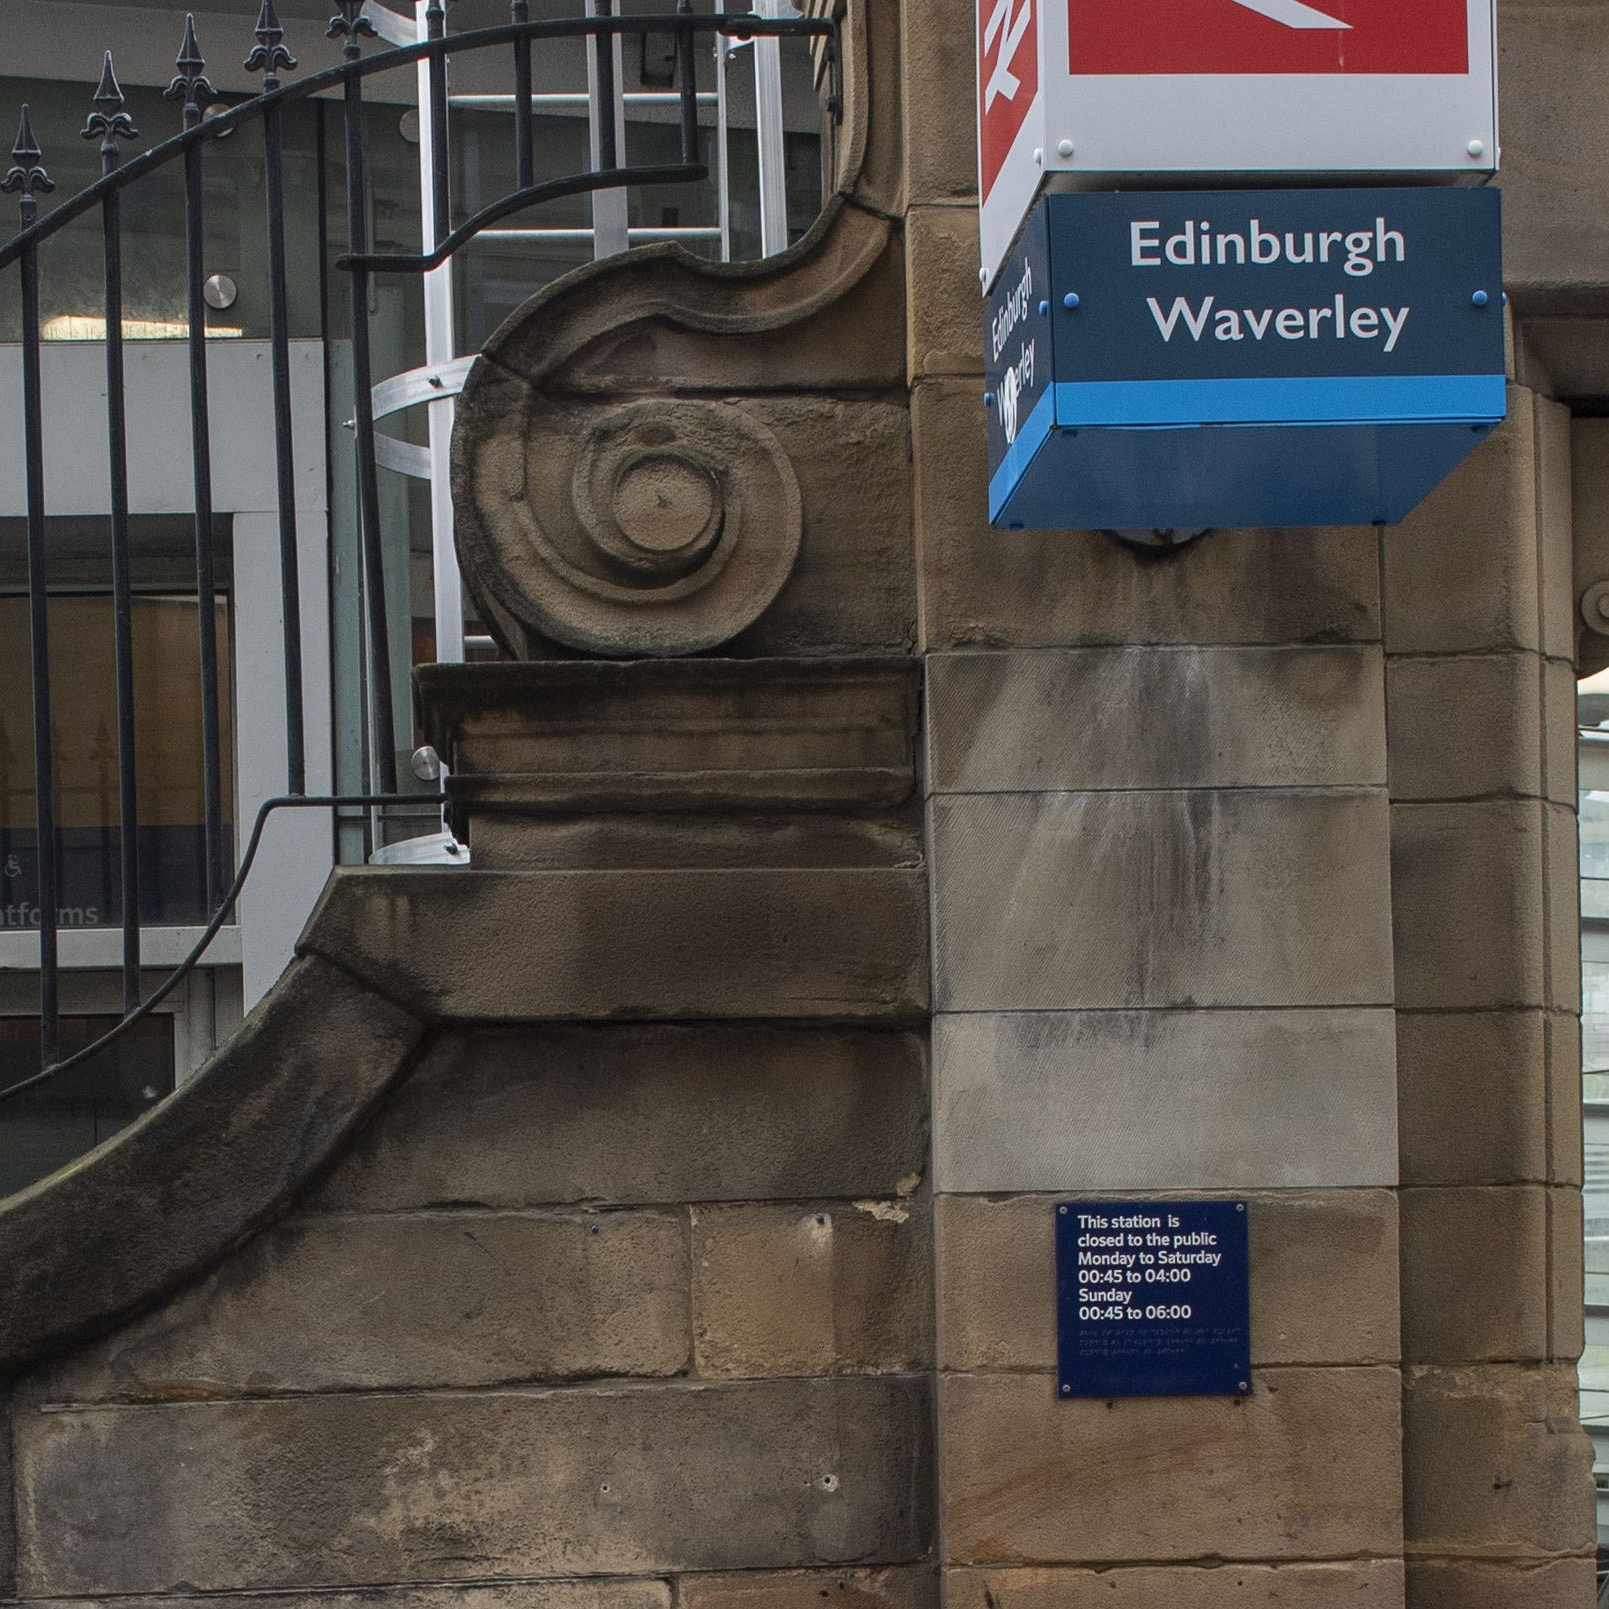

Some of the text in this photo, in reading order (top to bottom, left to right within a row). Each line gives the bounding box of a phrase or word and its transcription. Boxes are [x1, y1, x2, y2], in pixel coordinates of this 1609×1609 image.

[1130, 218, 1406, 277] Edinburgh
[992, 256, 1033, 363] Edinburgh
[1146, 294, 1410, 352] Waverley
[996, 338, 1036, 426] Werley
[1078, 1214, 1180, 1229] This station is
[1078, 1232, 1217, 1248] closed to the public
[1078, 1250, 1222, 1268] Monday to Saturday
[1078, 1269, 1191, 1283] 00:45 to 04:00
[1079, 1288, 1132, 1304] Sunday
[1079, 1305, 1192, 1320] 00:45 to 06:00
